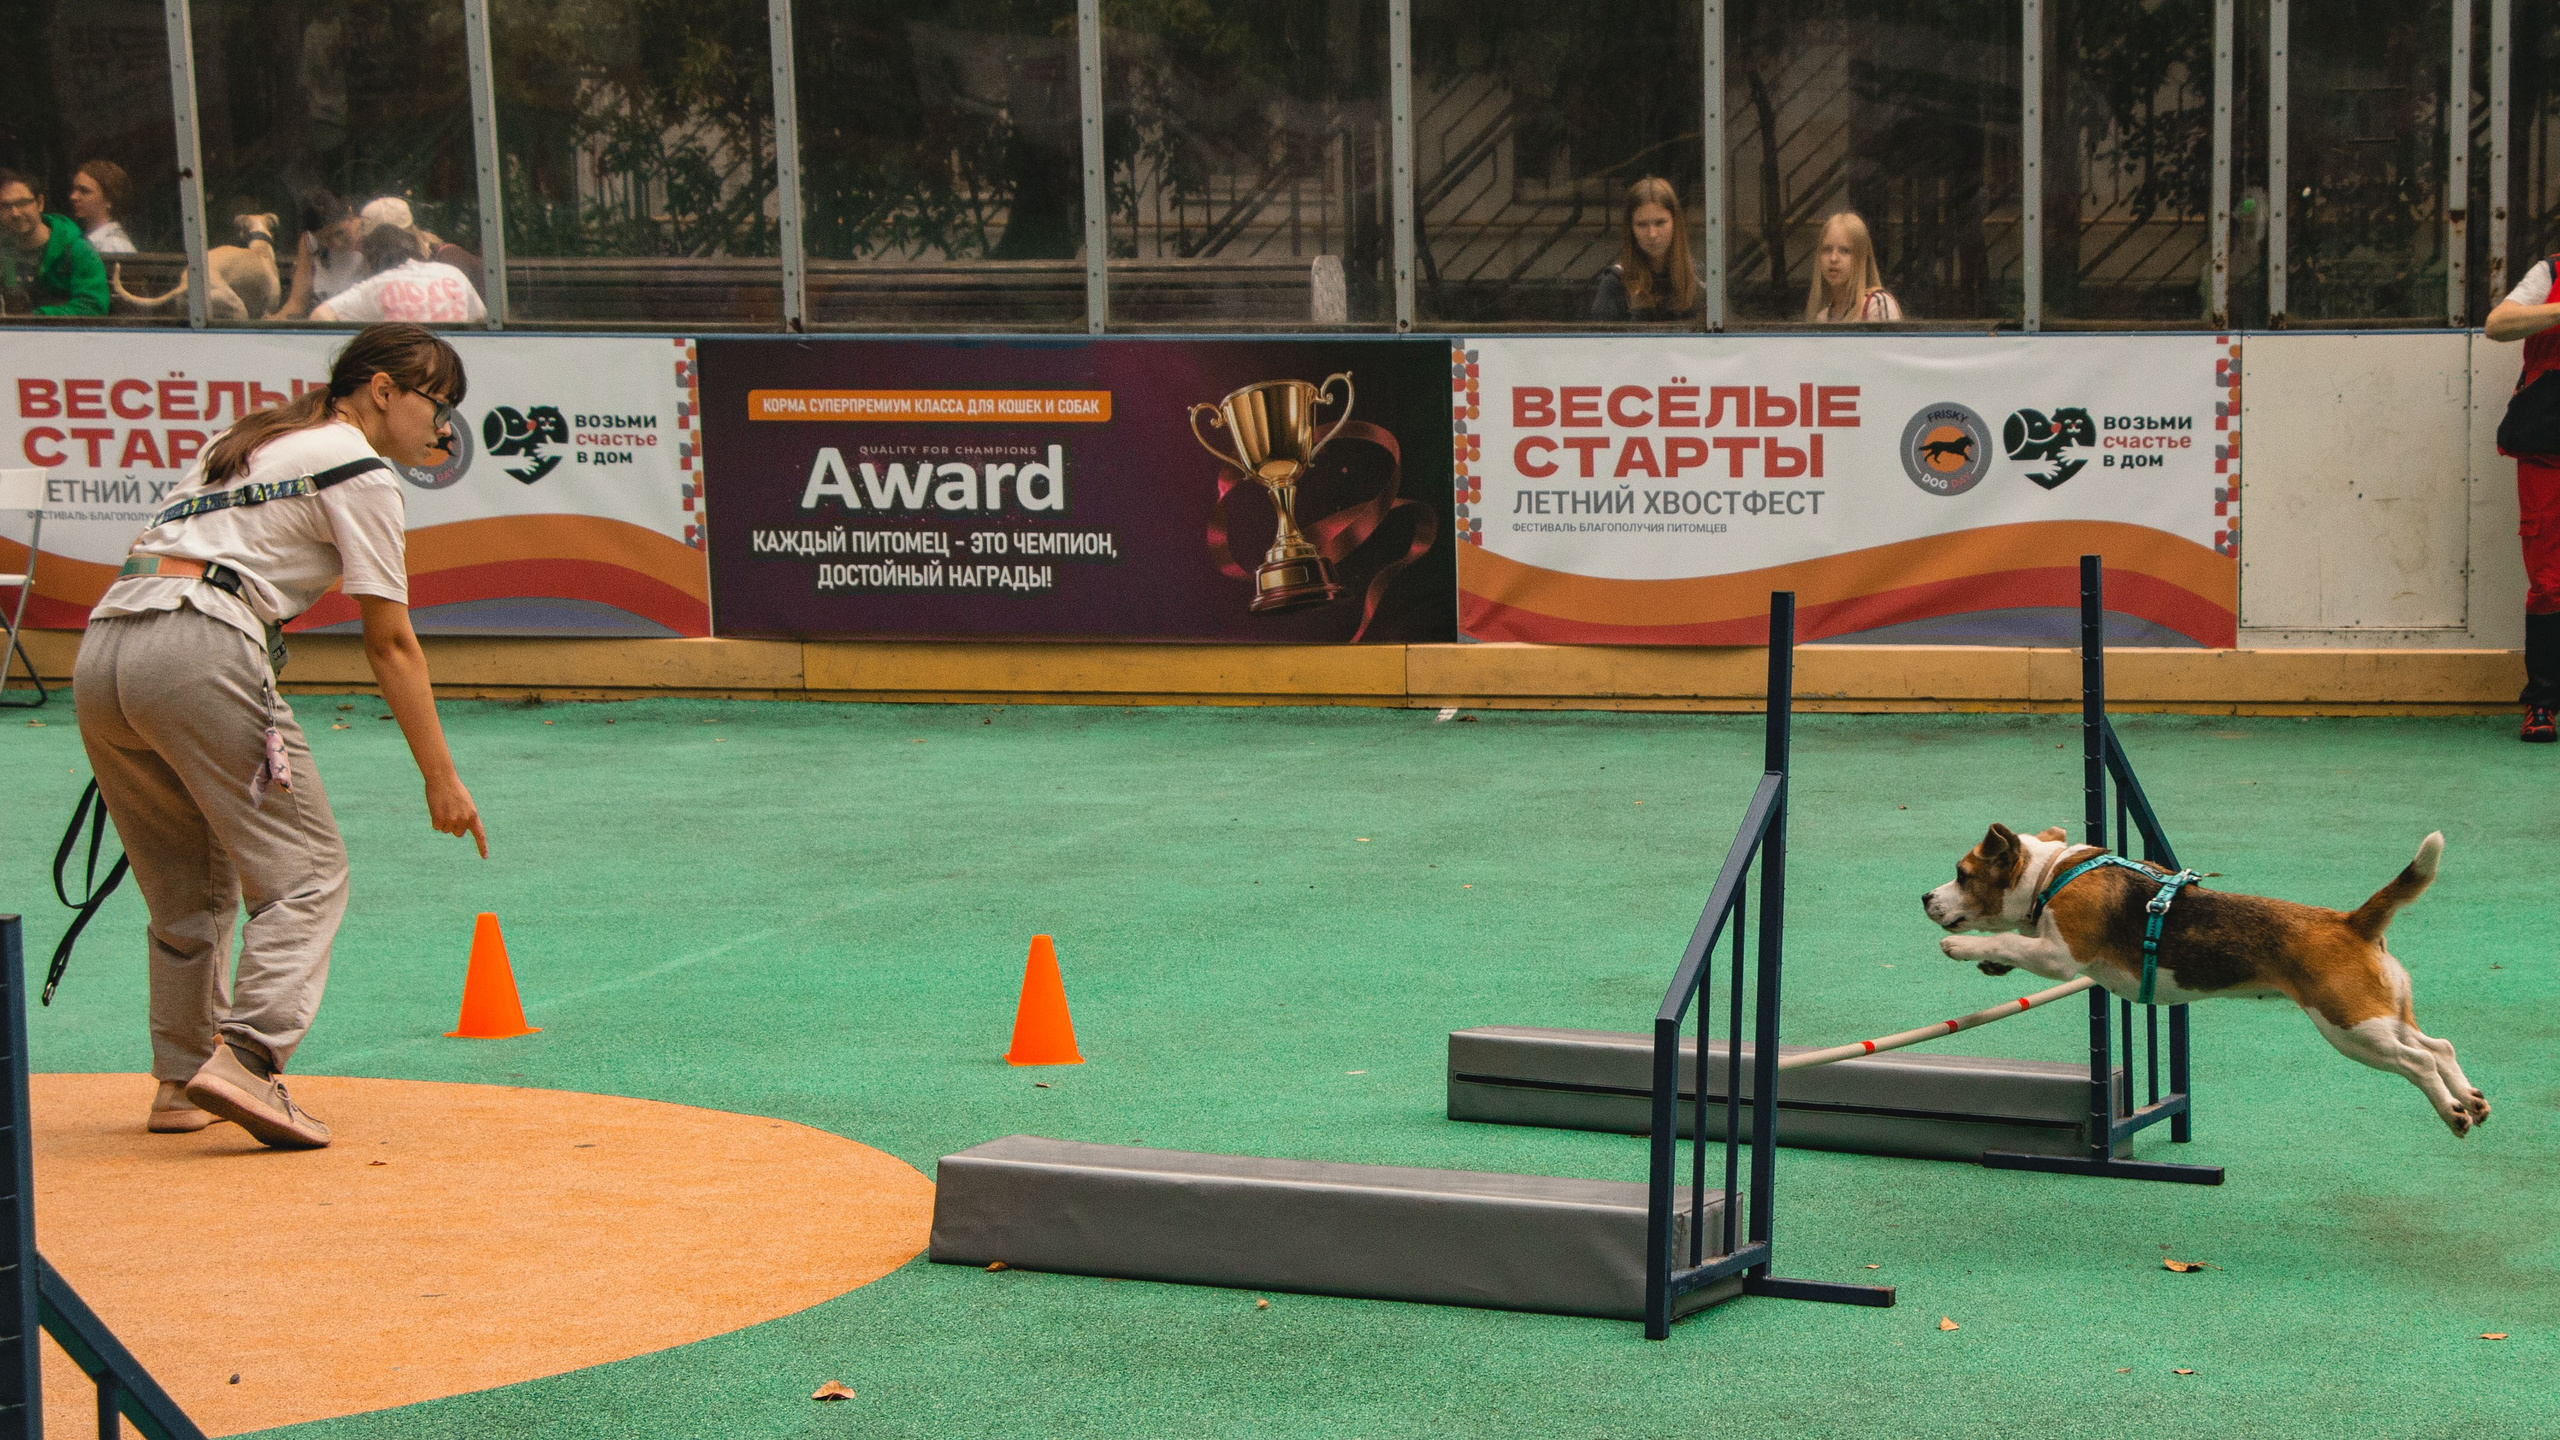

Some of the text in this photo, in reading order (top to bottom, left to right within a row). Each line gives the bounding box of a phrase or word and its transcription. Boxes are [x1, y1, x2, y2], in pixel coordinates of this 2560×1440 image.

[763, 398, 1099, 416] КОРМА СУПЕРПРЕМИУМ КЛАССА ДЛЯ КОШЕК И СОБАК
[1512, 376, 1861, 428] ВЕСЁЛЫЕ
[1927, 410, 1967, 422] FRISKY
[576, 432, 657, 446] счастье
[2103, 434, 2191, 449] счастье
[859, 446, 1037, 455] QUALITY FOR CHAMPIONS
[1513, 433, 1824, 478] СТАРТЫ
[409, 467, 434, 484] DOG
[801, 444, 1064, 510] Award
[1922, 473, 1948, 489] DOG
[47, 475, 140, 503] ЕТНИЙ
[1513, 484, 1825, 515] ЛЕТНИЙ ХВОСТФЕСТ
[27, 510, 87, 520] ФСТИВАЛЬ
[1512, 522, 1727, 534] ФЕСТИВАЛЬ БЛАГОПОЛУЧИЯ ПИТОМЦЕВ
[753, 526, 847, 556] КАЖДЫЙ
[852, 531, 949, 557] ПИТОМЕЦ
[971, 533, 1008, 553] ЭТО
[1013, 533, 1117, 558] ЧЕМПИОН,
[818, 559, 1052, 591] ДОСТОЙНЫЙ НАГРАДЫ!
